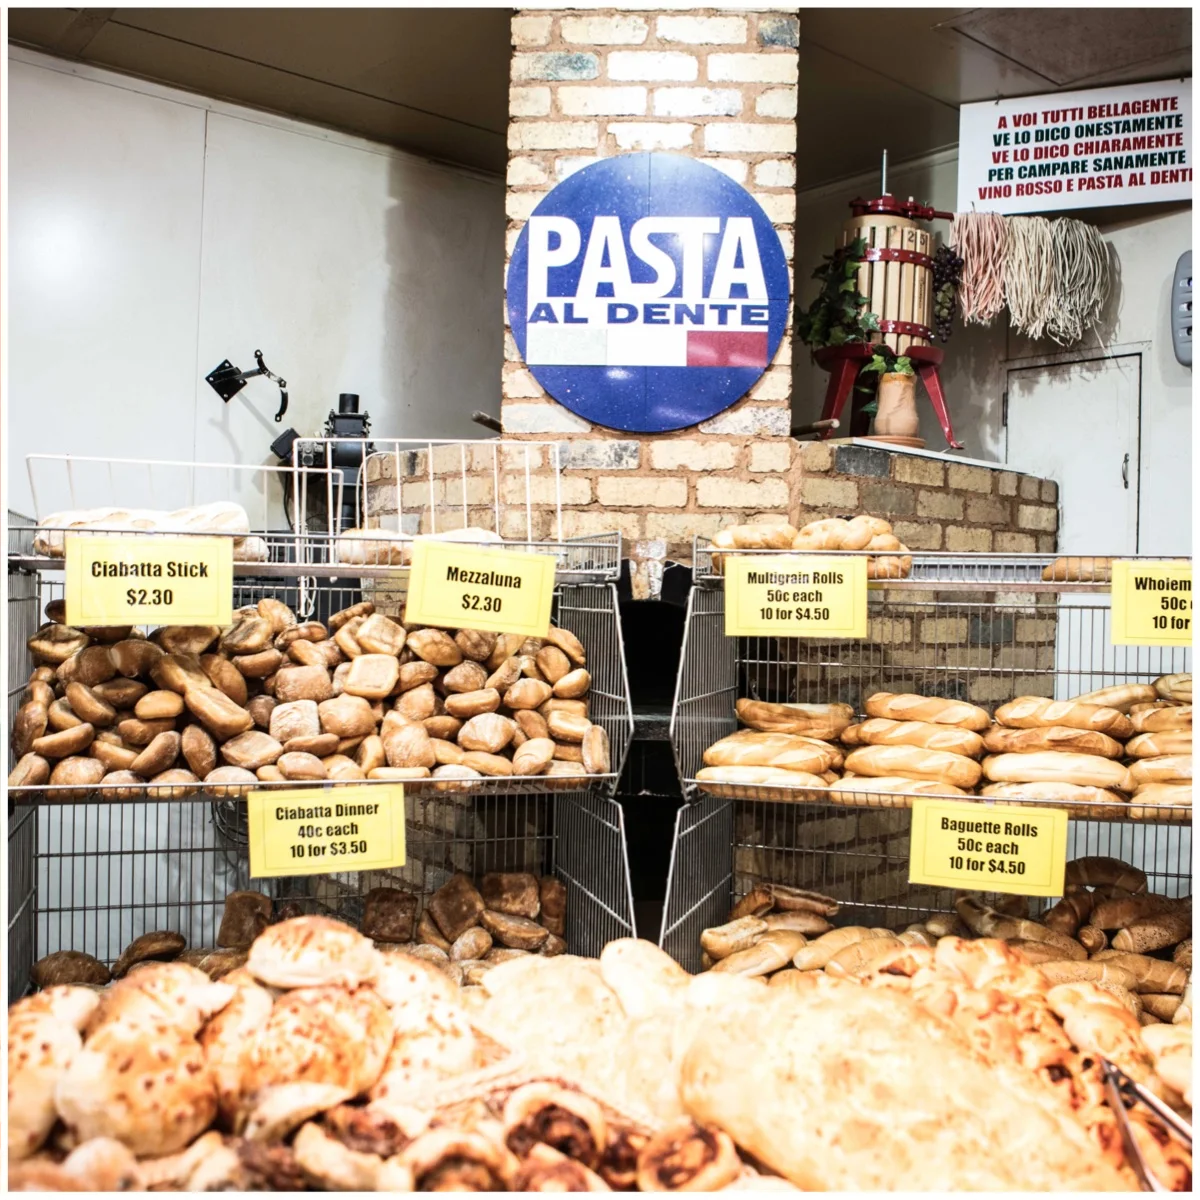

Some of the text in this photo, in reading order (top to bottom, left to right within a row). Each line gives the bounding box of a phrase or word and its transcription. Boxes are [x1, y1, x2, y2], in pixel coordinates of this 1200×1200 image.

[998, 96, 1179, 129] A VOI TUTTI BELLAGENTE
[993, 114, 1183, 147] VE LO DICO ONESTAMENTE
[992, 132, 1183, 164] VE LO DICO CHIARAMENTE
[988, 150, 1186, 182] PER CAMPARE SANAMENTE
[978, 184, 1012, 200] VINO
[1015, 179, 1063, 197] ROSSO
[1066, 178, 1074, 193] E
[1078, 175, 1123, 192] PASTA
[1128, 172, 1146, 188] AL
[528, 216, 769, 299] PASTA
[527, 303, 769, 326] AL DENTE
[91, 561, 208, 578] Ciabatta Stick
[446, 565, 522, 589] Mezzaluna
[747, 571, 844, 587] Multigrain Rolls
[126, 588, 173, 607] $2.30
[461, 593, 502, 613] $2.30
[767, 589, 823, 603] 50c each
[1161, 596, 1187, 610] 50c
[760, 606, 830, 622] 10 for $4.50
[1152, 615, 1191, 630] 10 for
[275, 802, 380, 821] Ciabatta Dinner
[298, 821, 358, 839] 40c each
[940, 817, 1038, 838] Baguette Rolls
[290, 839, 367, 858] 10 for $3.50
[957, 838, 1019, 856] 50c each
[949, 856, 1026, 875] 10 for $4.50
